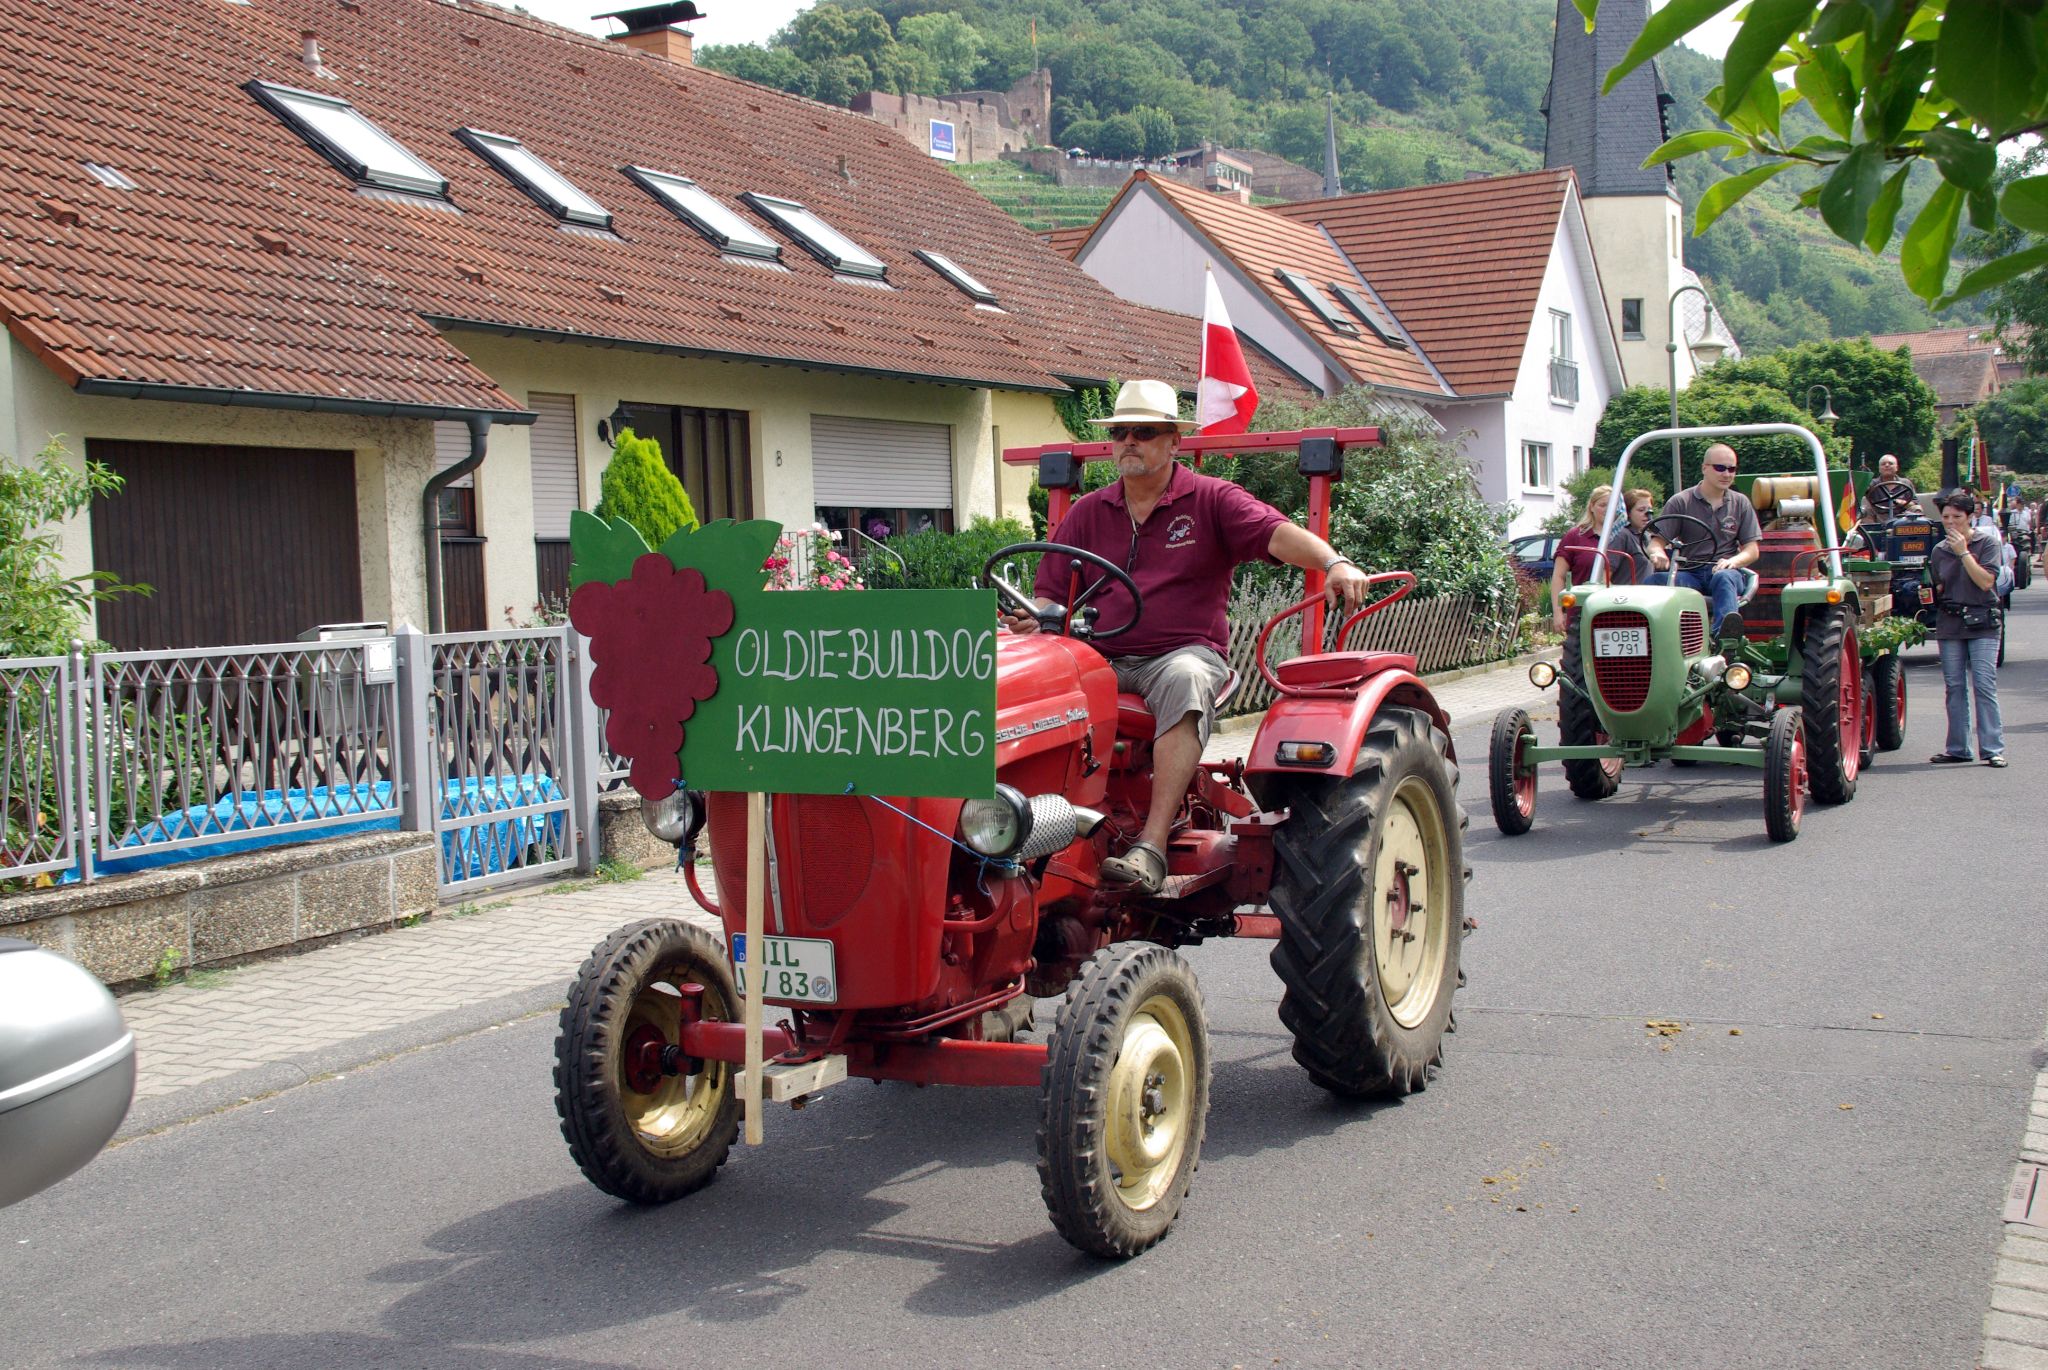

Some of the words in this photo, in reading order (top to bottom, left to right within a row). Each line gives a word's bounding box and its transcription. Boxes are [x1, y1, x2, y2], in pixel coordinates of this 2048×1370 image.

[776, 450, 782, 467] 8
[1601, 644, 1610, 655] E
[1617, 643, 1639, 655] 791
[1611, 630, 1640, 642] OBB
[735, 628, 993, 681] OLDIE-BULLDOG
[735, 704, 985, 758] KLINGENBERG
[763, 941, 800, 967] IL
[779, 971, 809, 997] 83
